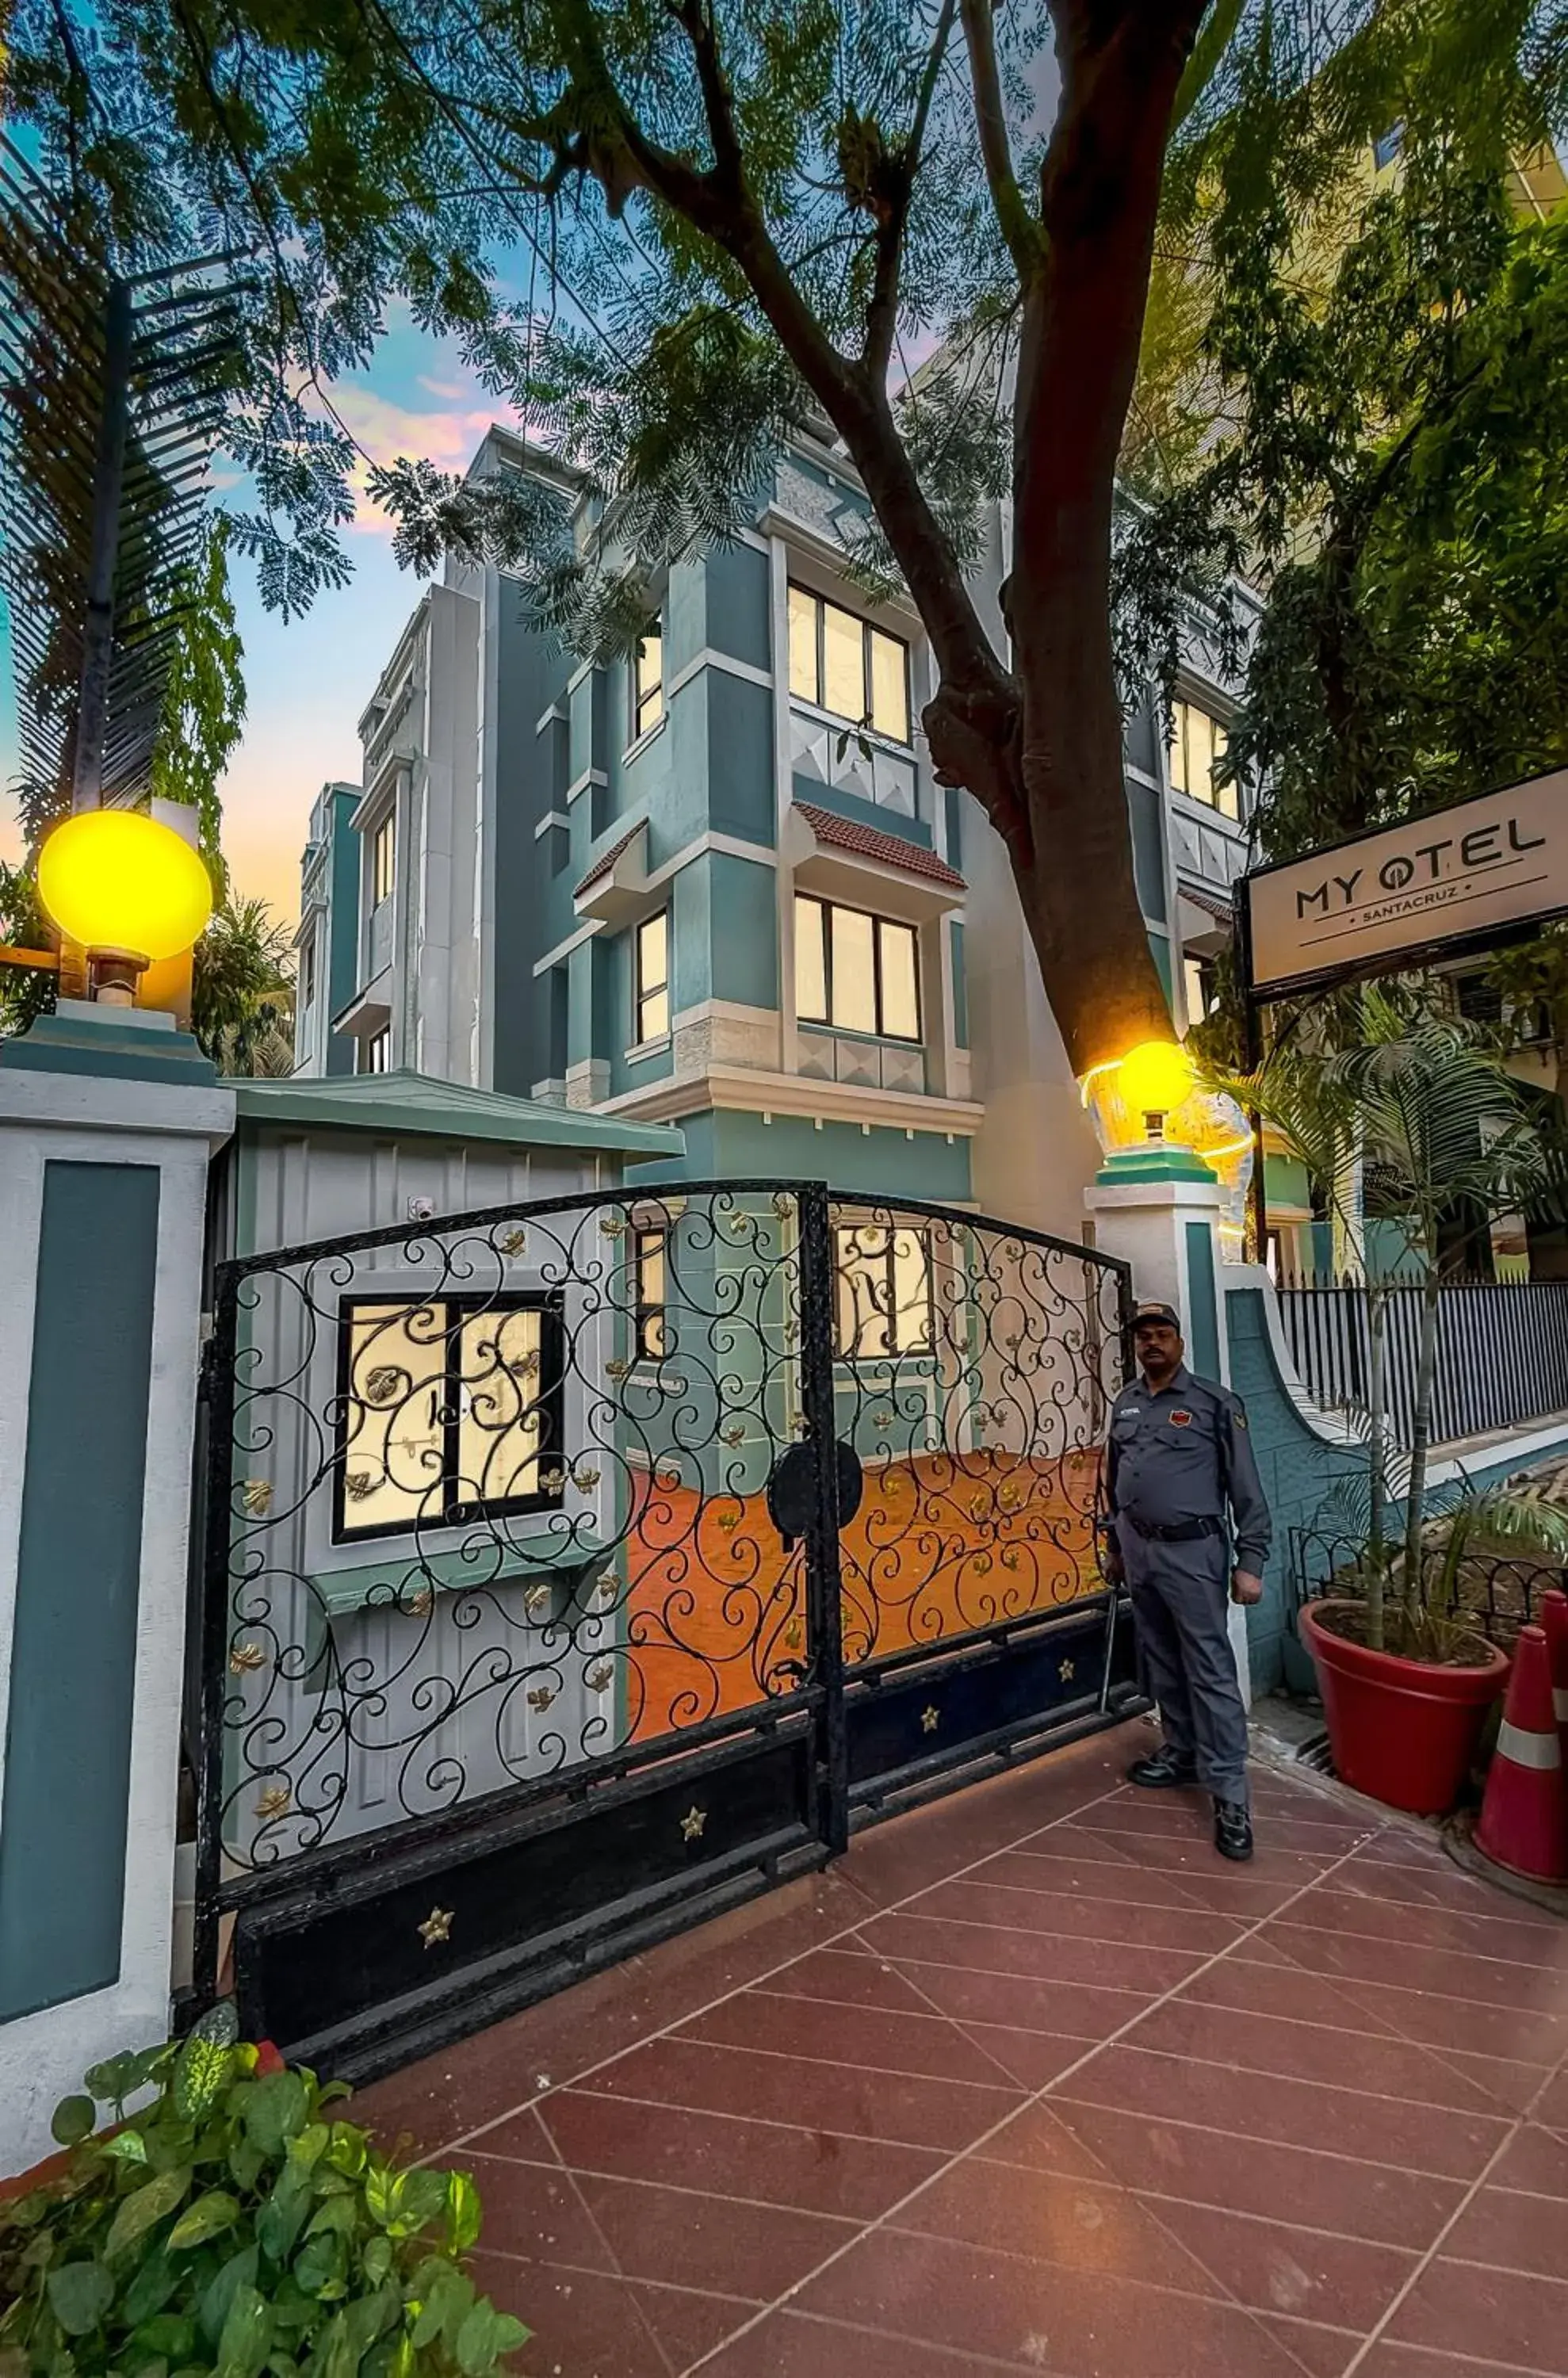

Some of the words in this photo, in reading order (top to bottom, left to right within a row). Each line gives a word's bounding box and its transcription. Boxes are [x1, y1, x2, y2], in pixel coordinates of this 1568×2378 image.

[1296, 869, 1363, 919] MY
[1379, 818, 1546, 889] OTEL
[1363, 887, 1458, 922] SANTACRUZ
